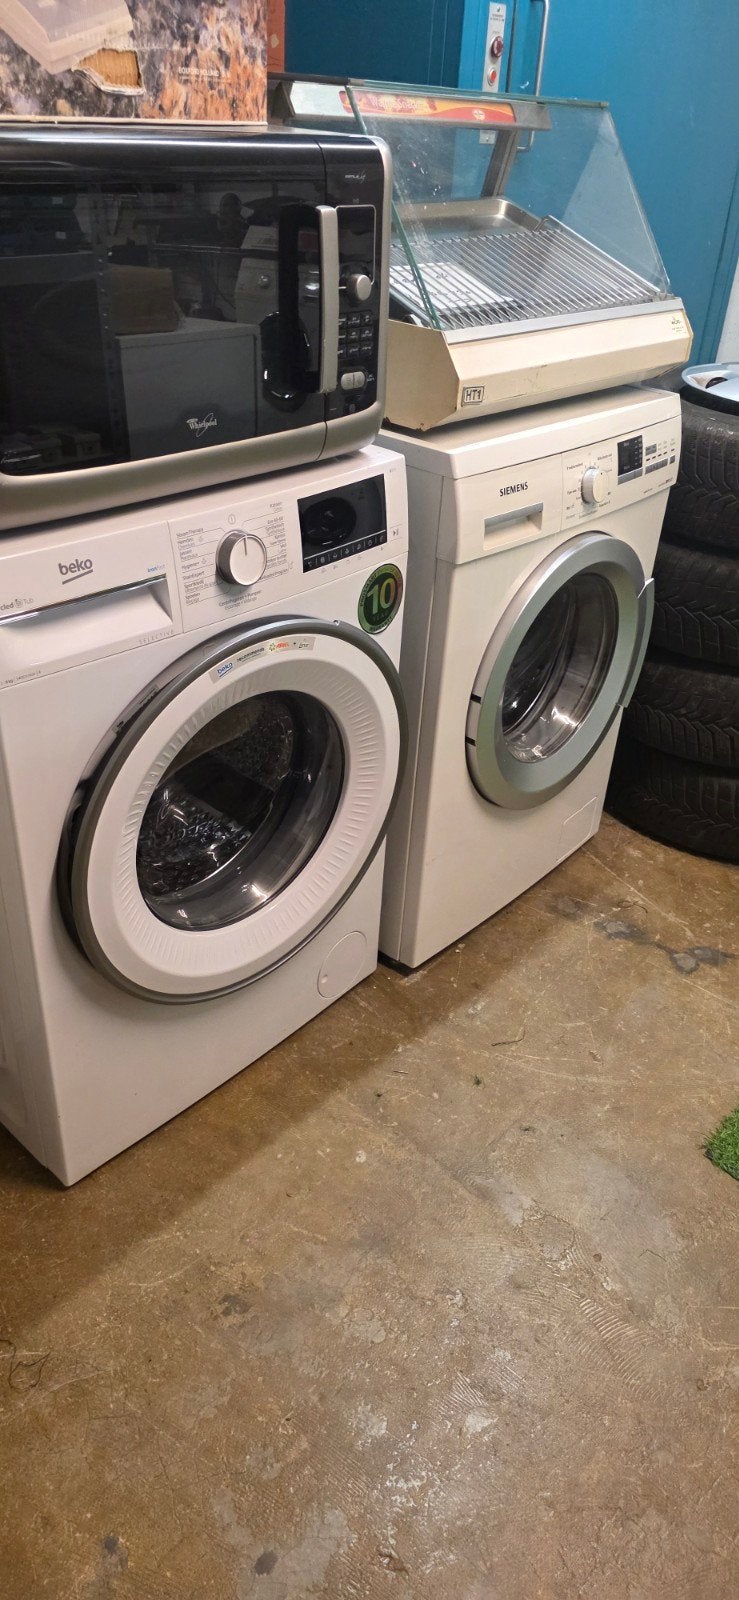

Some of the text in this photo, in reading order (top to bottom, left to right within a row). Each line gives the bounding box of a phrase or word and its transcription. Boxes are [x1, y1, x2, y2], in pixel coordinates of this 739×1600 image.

[465, 389, 481, 401] HT1
[186, 413, 217, 436] Whirlpool
[499, 481, 528, 497] SIEMENS
[58, 558, 93, 577] beko
[366, 577, 396, 614] 10
[0, 602, 14, 611] cled
[138, 629, 174, 645] SELECTIVE
[217, 662, 233, 674] beko
